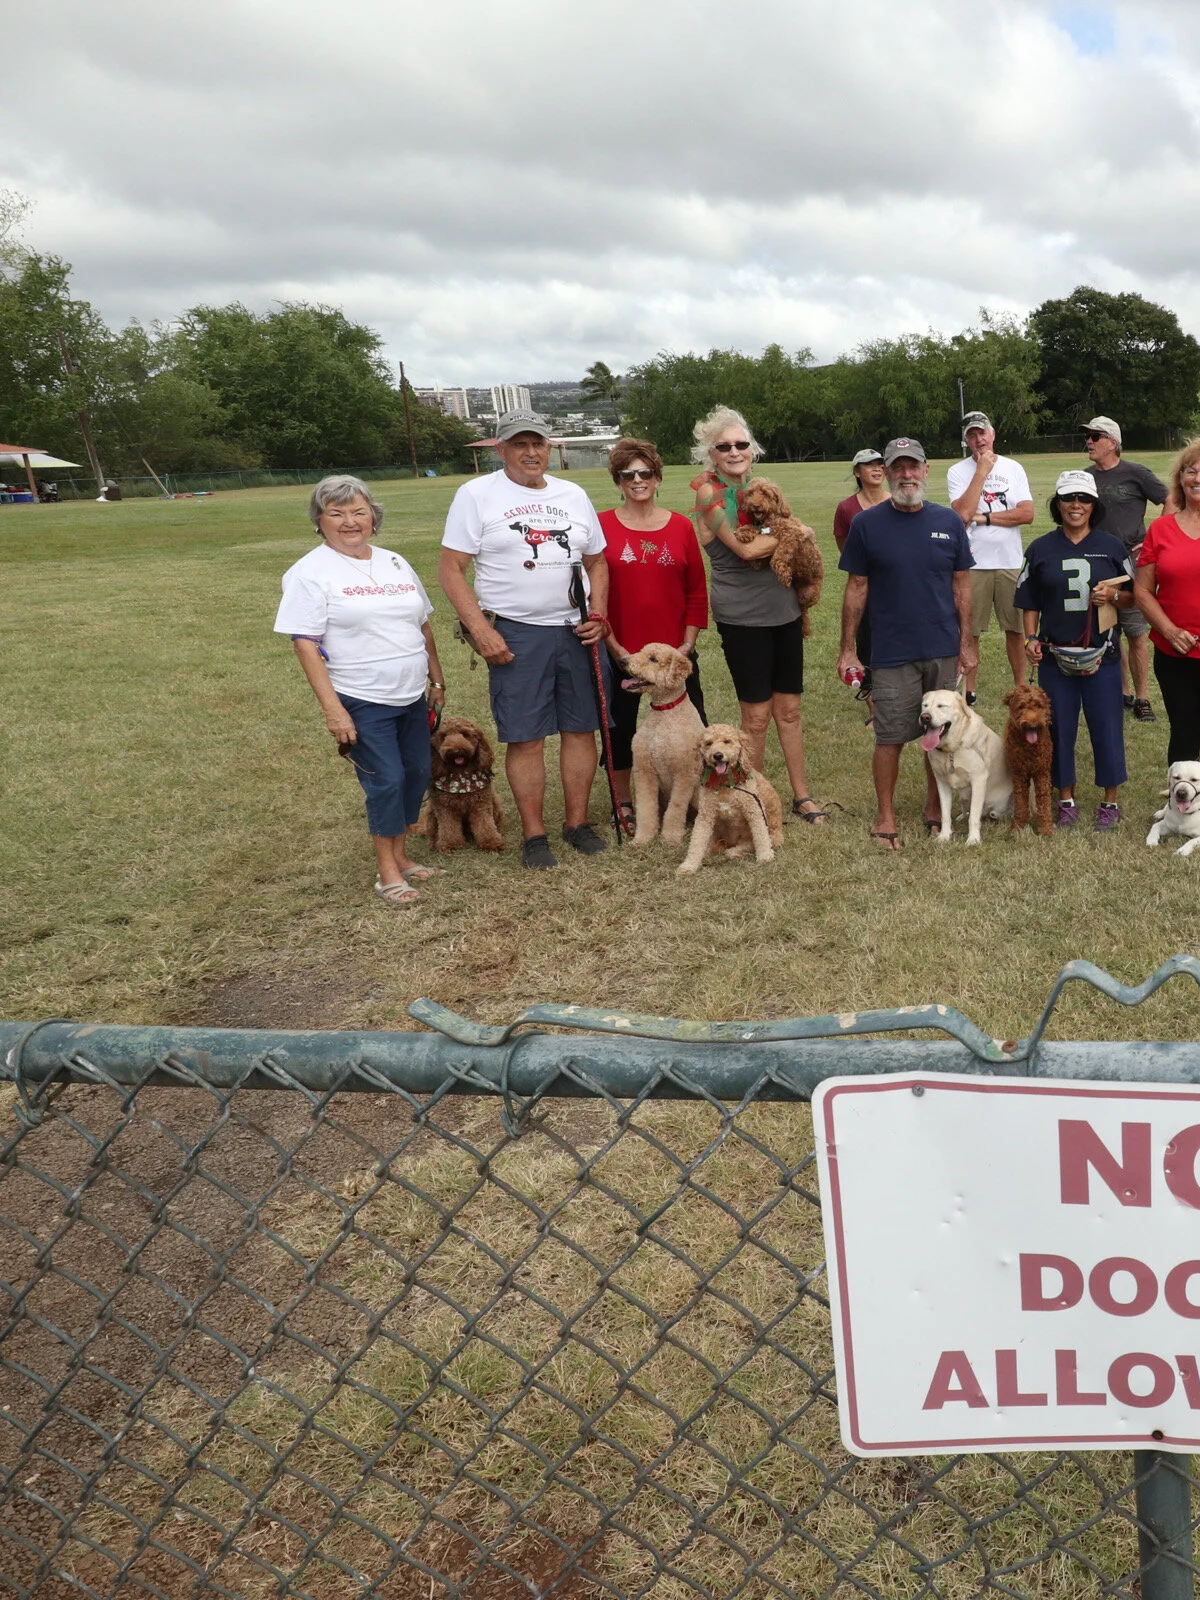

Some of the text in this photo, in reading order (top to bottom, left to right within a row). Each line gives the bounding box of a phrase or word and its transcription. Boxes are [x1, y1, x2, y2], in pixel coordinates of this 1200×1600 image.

[504, 504, 569, 519] SERVICE DOGS
[522, 525, 568, 542] heroes
[1062, 558, 1091, 611] 3
